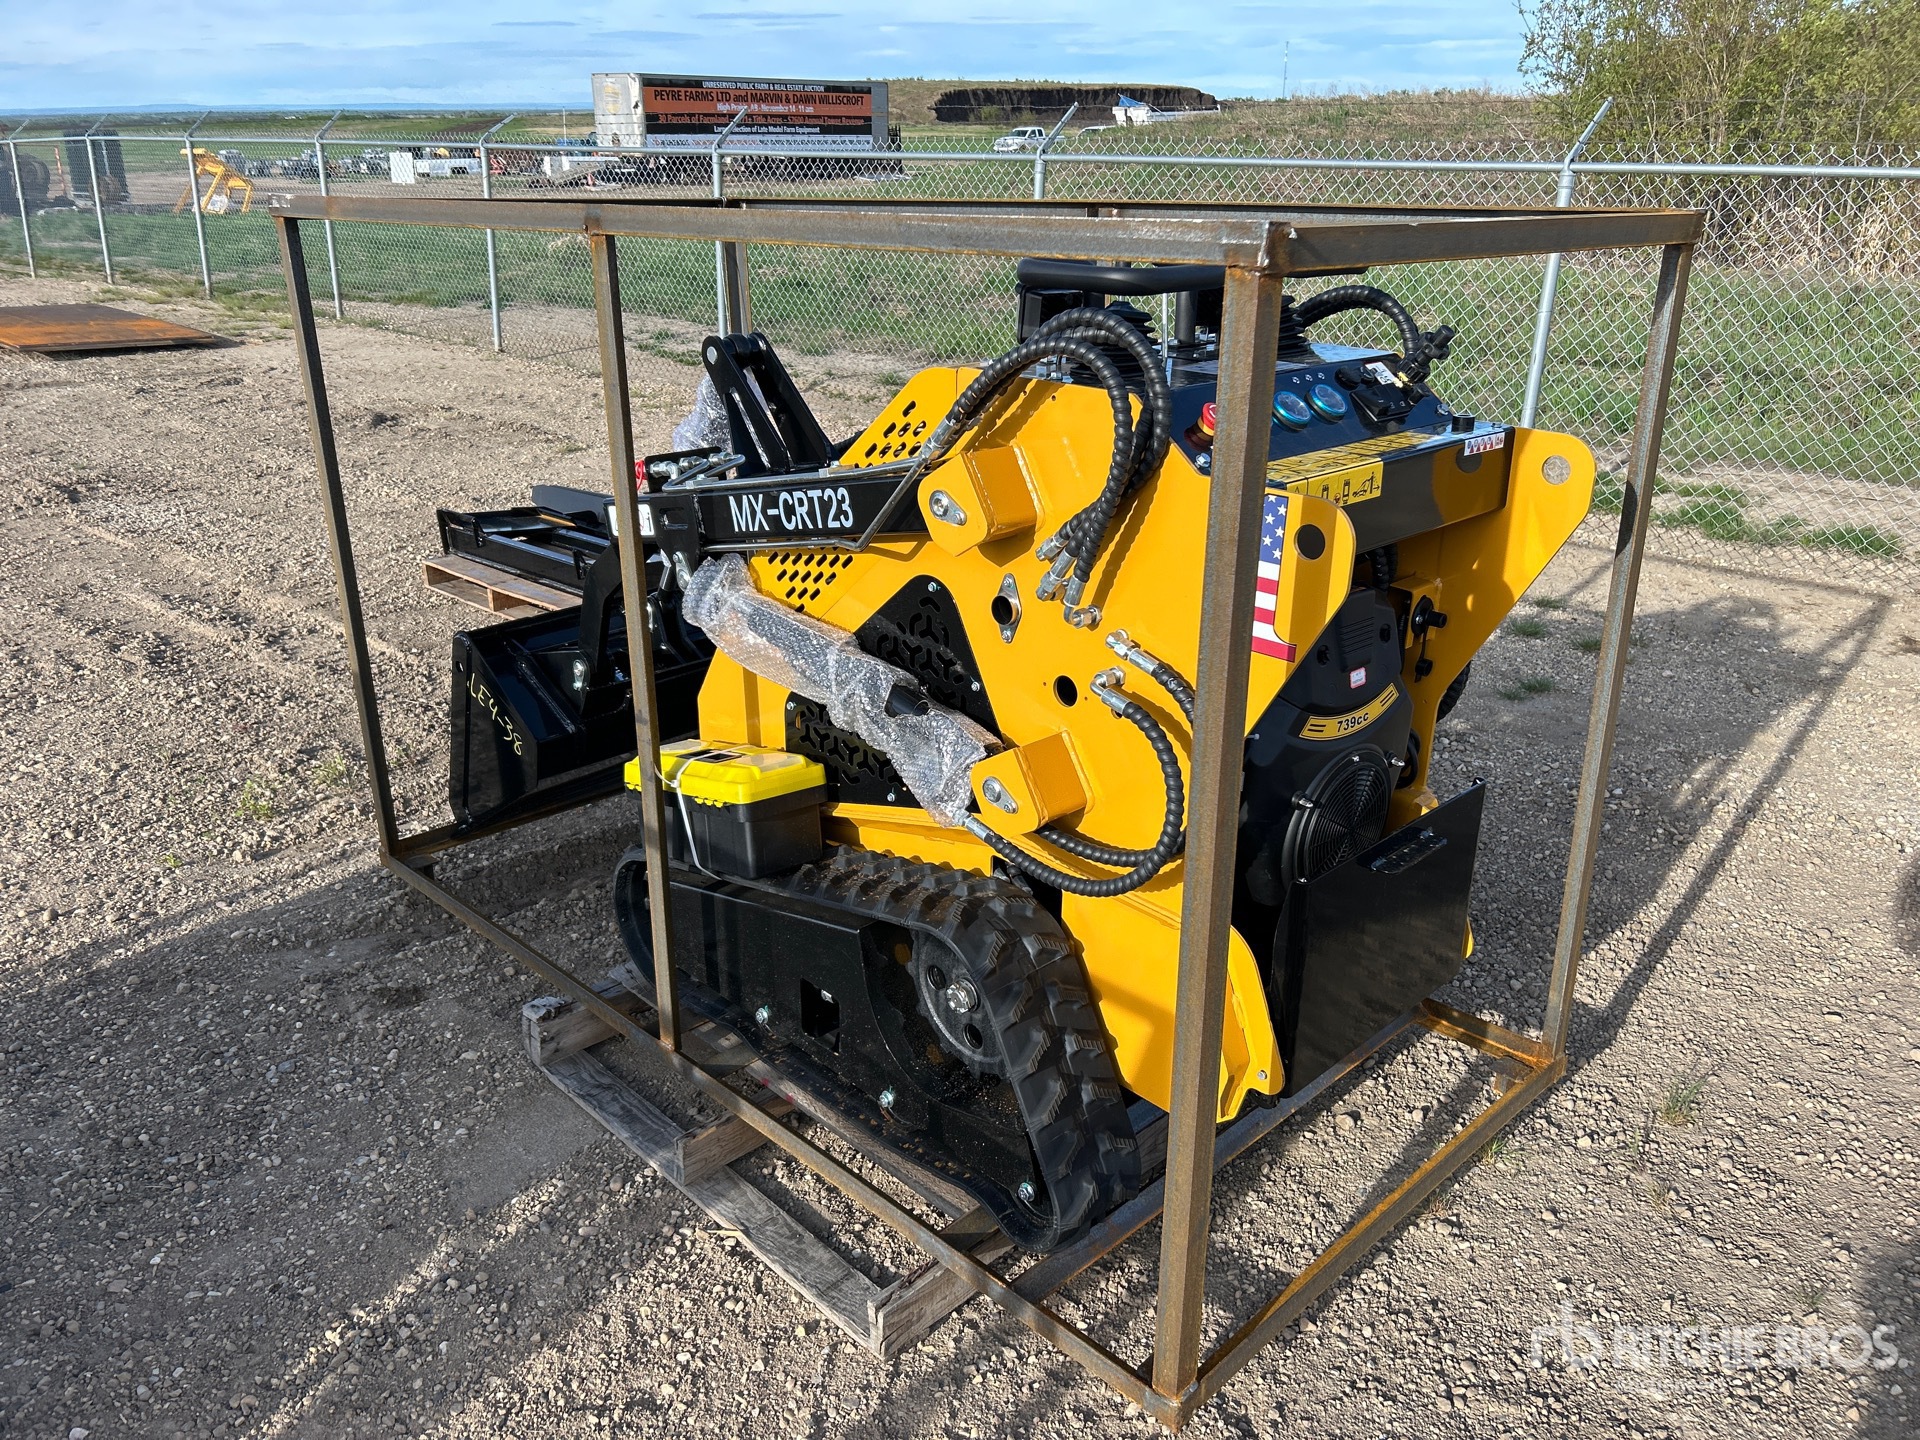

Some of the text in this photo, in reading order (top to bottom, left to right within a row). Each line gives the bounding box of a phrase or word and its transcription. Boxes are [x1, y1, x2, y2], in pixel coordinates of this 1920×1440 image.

[654, 90, 864, 106] PEYRE FARMS LTD and MARVIN & DAWN WILLISCROFT
[728, 487, 853, 532] MX-CRT23
[1337, 712, 1369, 733] 739cc
